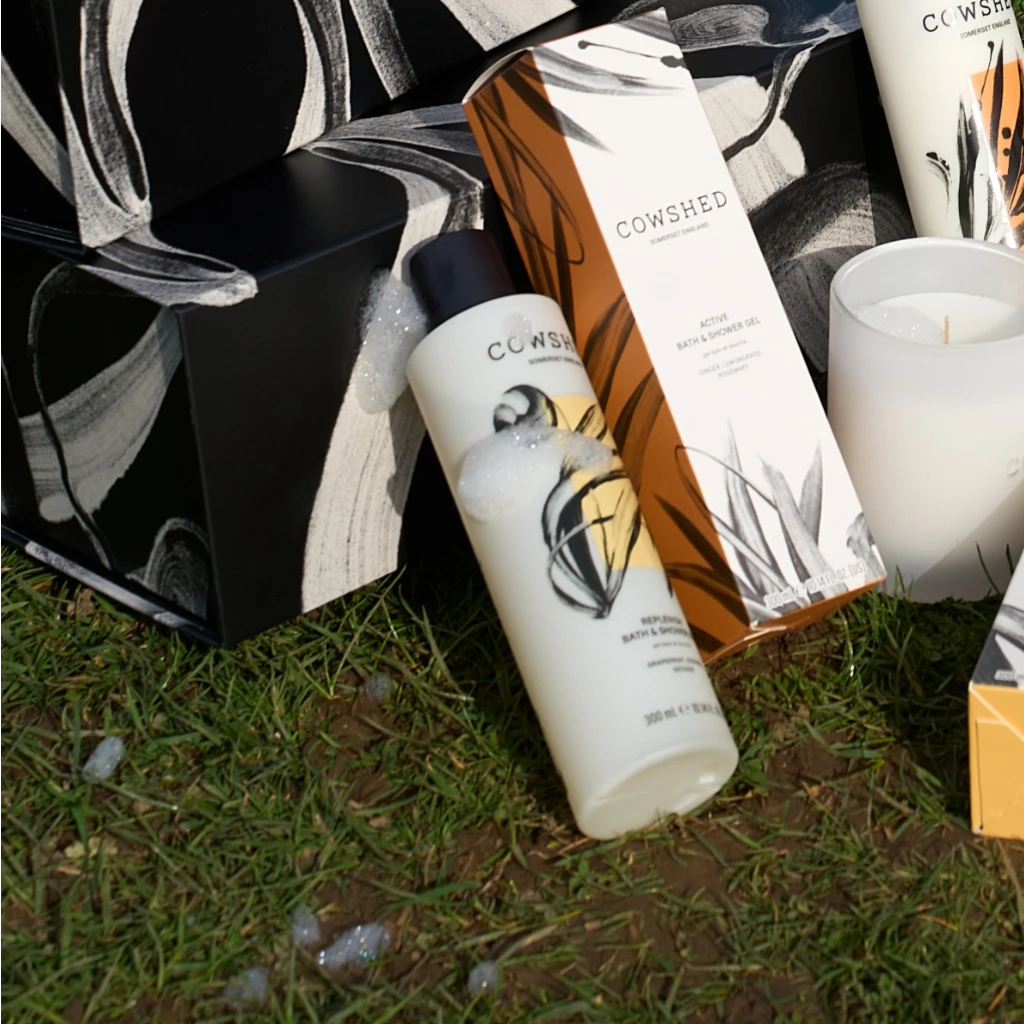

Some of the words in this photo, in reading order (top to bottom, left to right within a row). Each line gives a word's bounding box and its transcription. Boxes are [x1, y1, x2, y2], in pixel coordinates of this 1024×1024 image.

[616, 190, 727, 239] COWSHED
[649, 230, 681, 246] SOMERSET
[682, 221, 710, 236] ENGLAND
[700, 312, 729, 329] ACTIVE
[676, 337, 700, 351] BATH
[700, 334, 707, 343] &
[707, 321, 744, 341] SHOWER
[744, 316, 762, 328] GEL
[621, 628, 650, 644] BATH
[651, 627, 657, 636] &
[644, 709, 664, 726] 300
